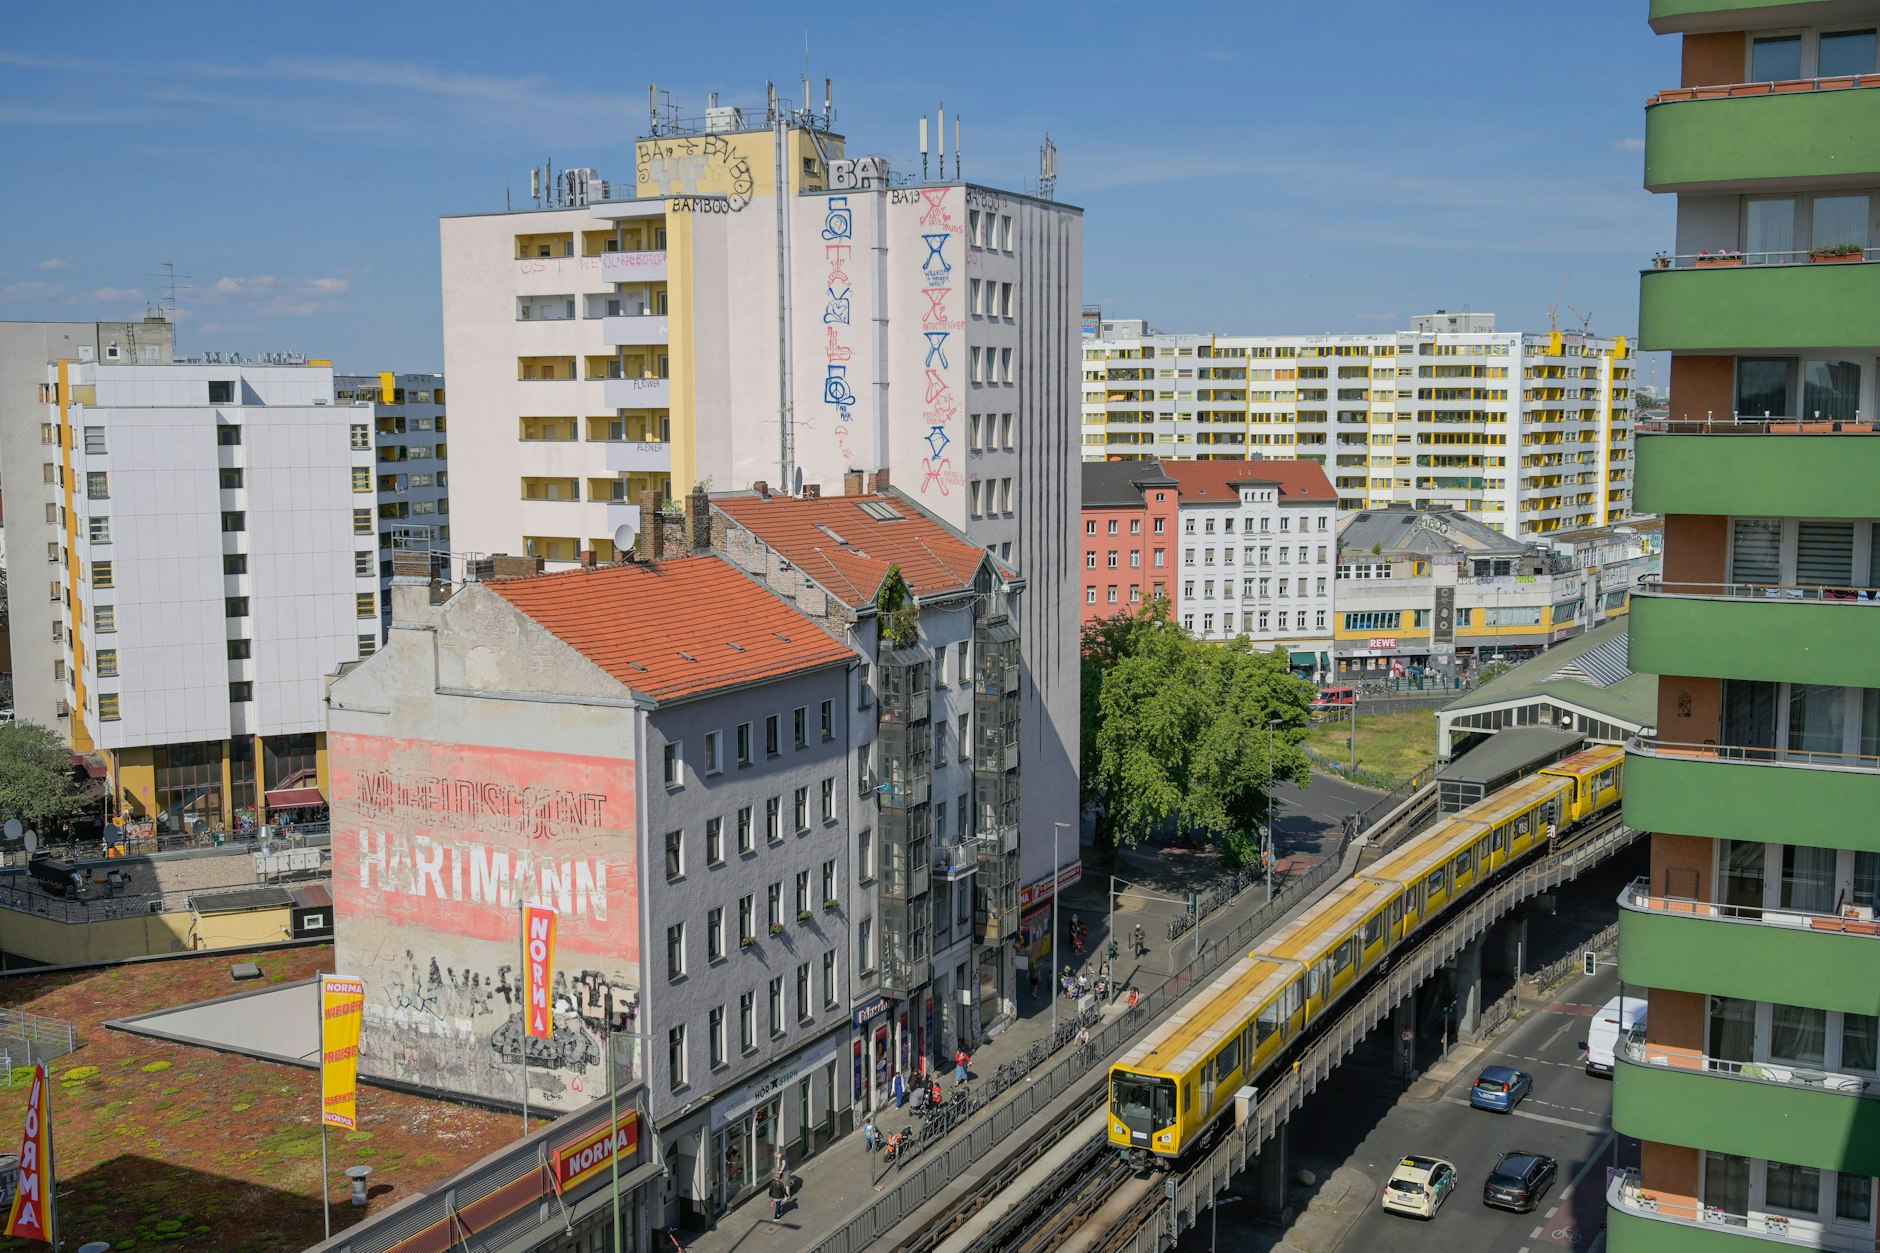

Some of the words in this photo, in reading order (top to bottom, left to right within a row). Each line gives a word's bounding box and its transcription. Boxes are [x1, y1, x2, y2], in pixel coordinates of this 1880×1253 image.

[672, 198, 730, 213] BAMBOO
[634, 379, 661, 390] FLOWER
[637, 443, 662, 452] FLOWER
[1370, 638, 1396, 648] REWE
[359, 828, 608, 922] HARTMANN
[326, 983, 363, 993] NORMA
[324, 1000, 363, 1020] WIEDER
[324, 1045, 357, 1065] PREISE
[754, 1085, 772, 1102] HÖR
[779, 1068, 799, 1088] STERN
[325, 1113, 354, 1127] NORMA
[569, 1129, 628, 1177] NORMA
